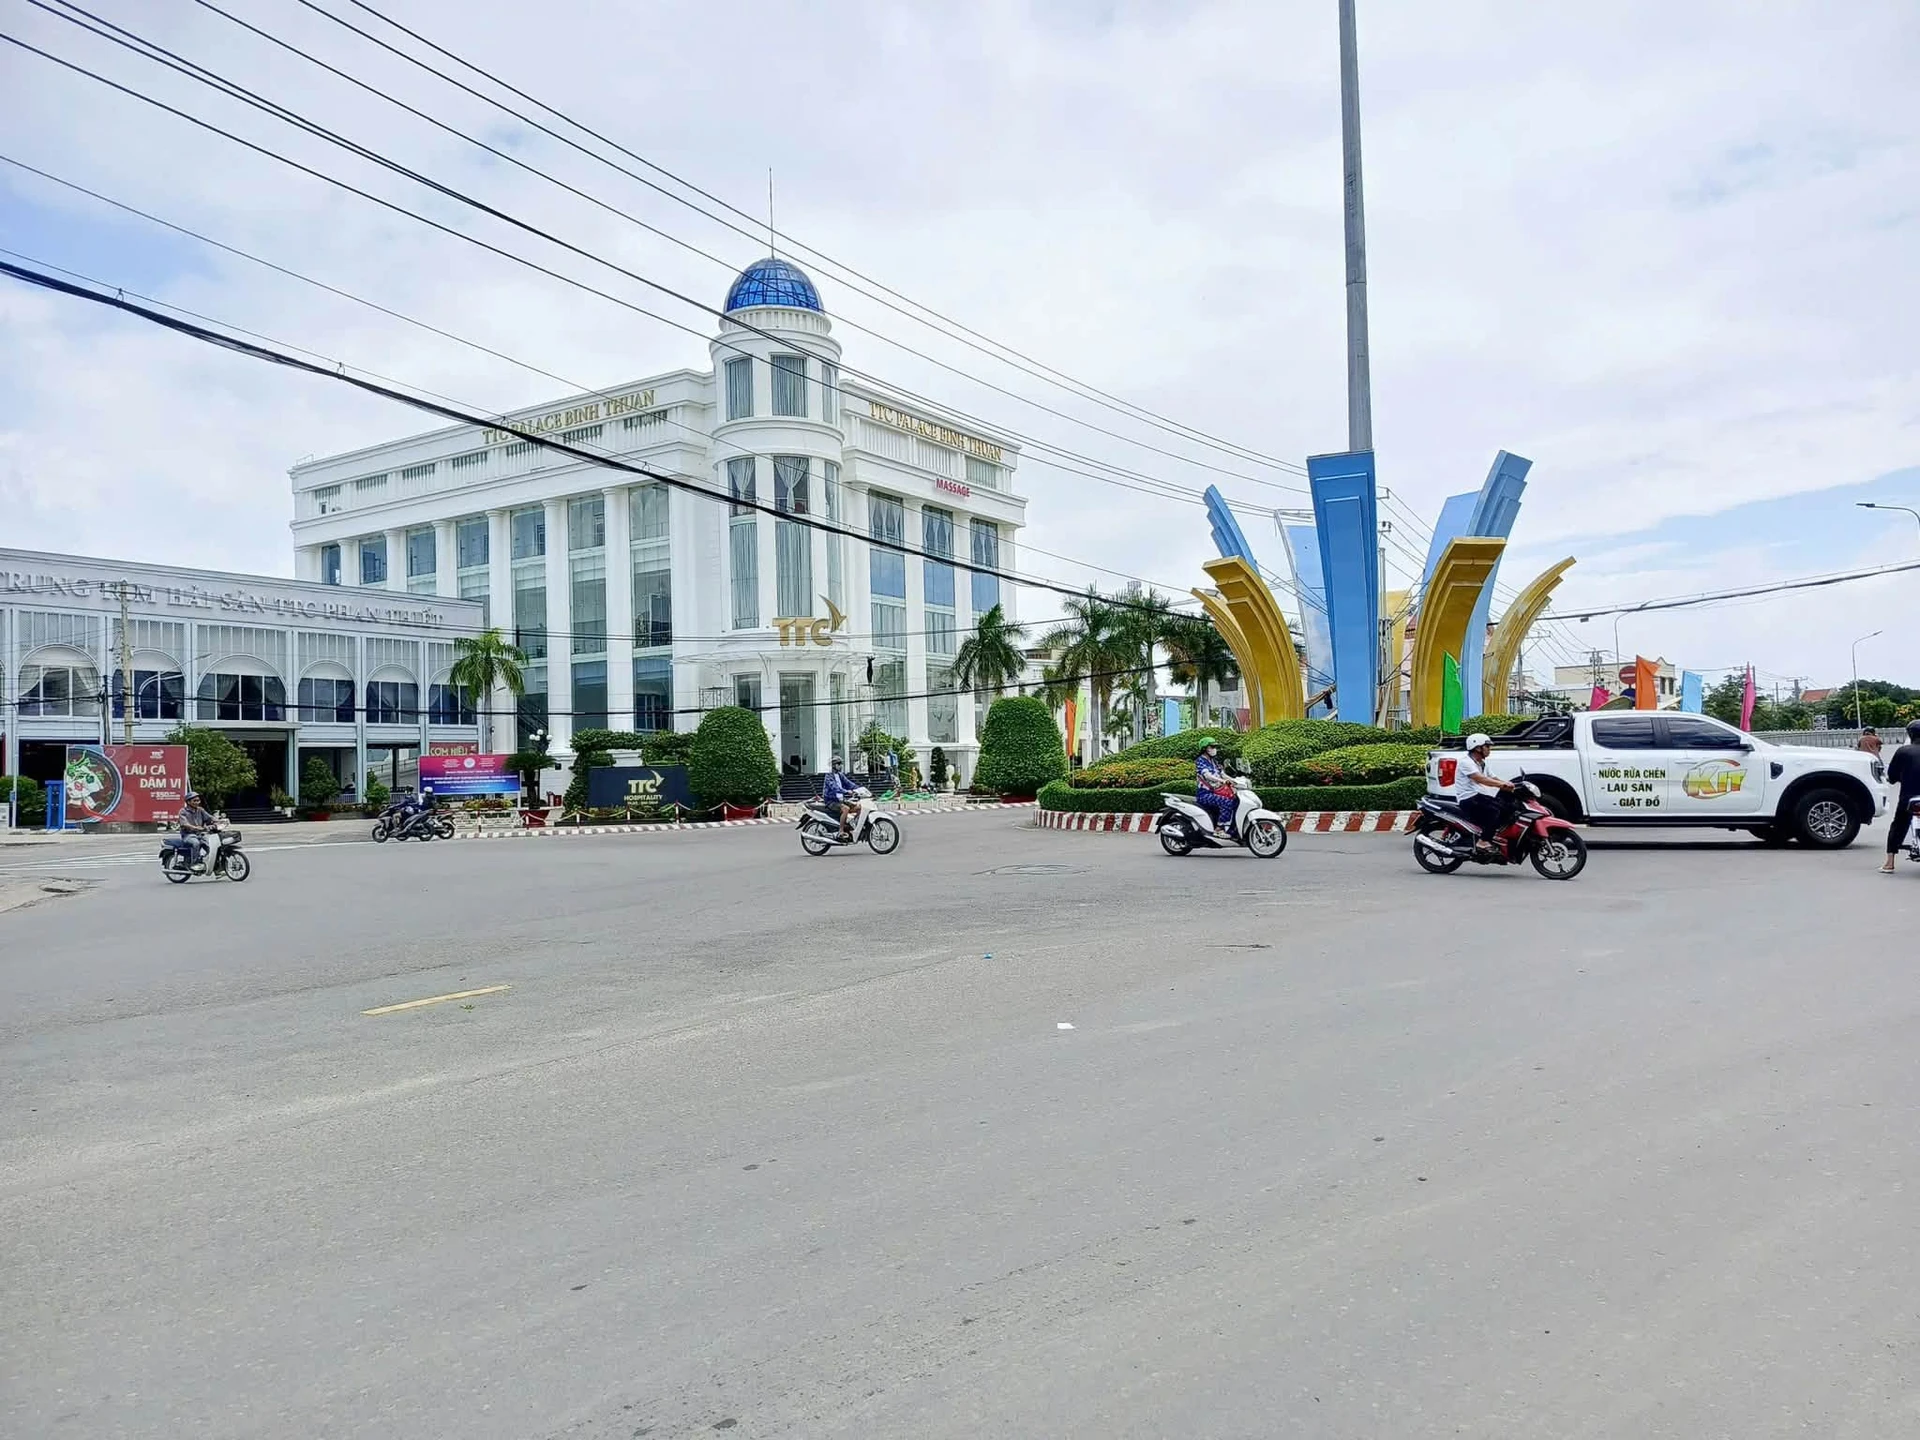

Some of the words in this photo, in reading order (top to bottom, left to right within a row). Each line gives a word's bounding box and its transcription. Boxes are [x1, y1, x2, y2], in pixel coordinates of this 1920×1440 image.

[869, 402, 893, 423] TTC
[896, 411, 937, 439] PALACE
[936, 477, 970, 497] MASSAGE
[274, 597, 316, 619] TTC
[323, 601, 380, 624] PHAN
[772, 617, 833, 647] TTC
[1643, 767, 1666, 779] CHÉN
[1687, 766, 1748, 797] KIT
[628, 779, 658, 793] TTC
[1607, 783, 1628, 792] LAU
